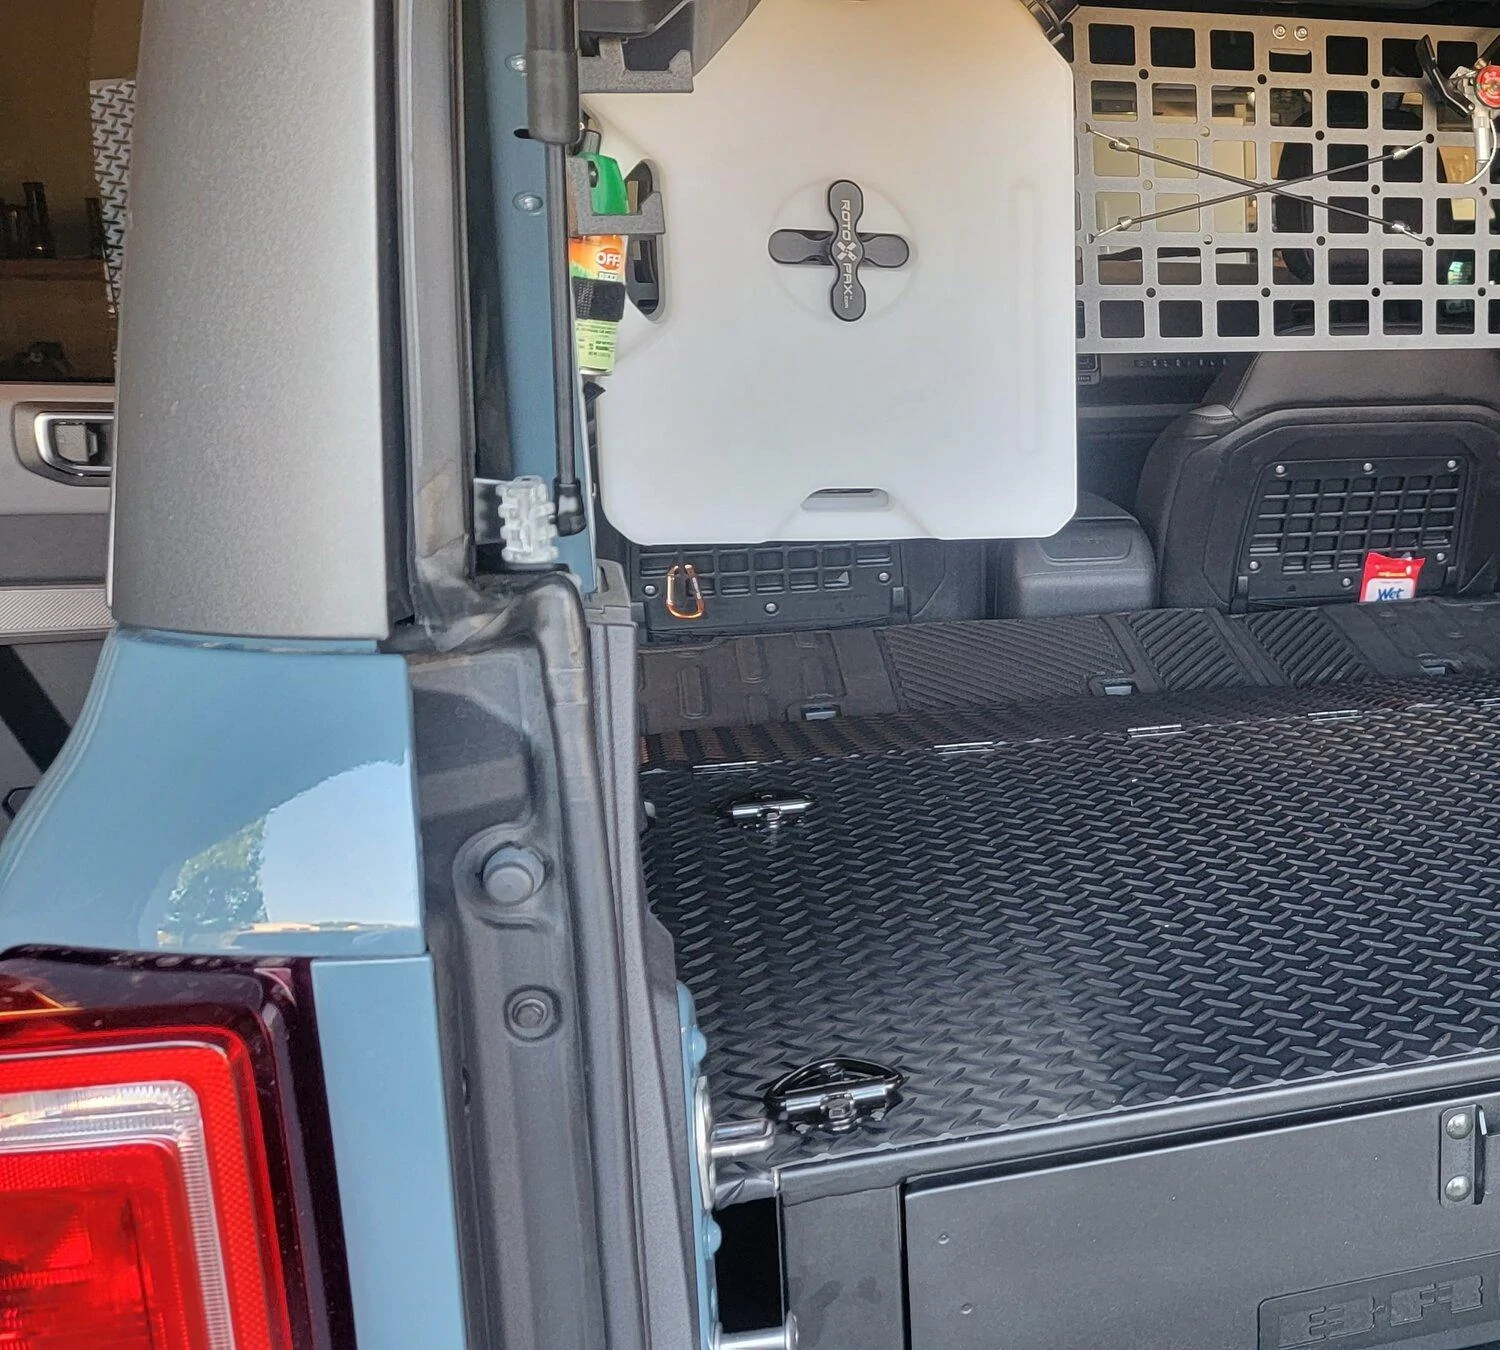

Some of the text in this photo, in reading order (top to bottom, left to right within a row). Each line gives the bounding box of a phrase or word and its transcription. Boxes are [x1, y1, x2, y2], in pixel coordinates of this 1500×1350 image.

[840, 199, 851, 241] ROTO
[595, 251, 621, 267] OFF!
[843, 262, 853, 295] PAX
[1377, 587, 1405, 600] Wet
